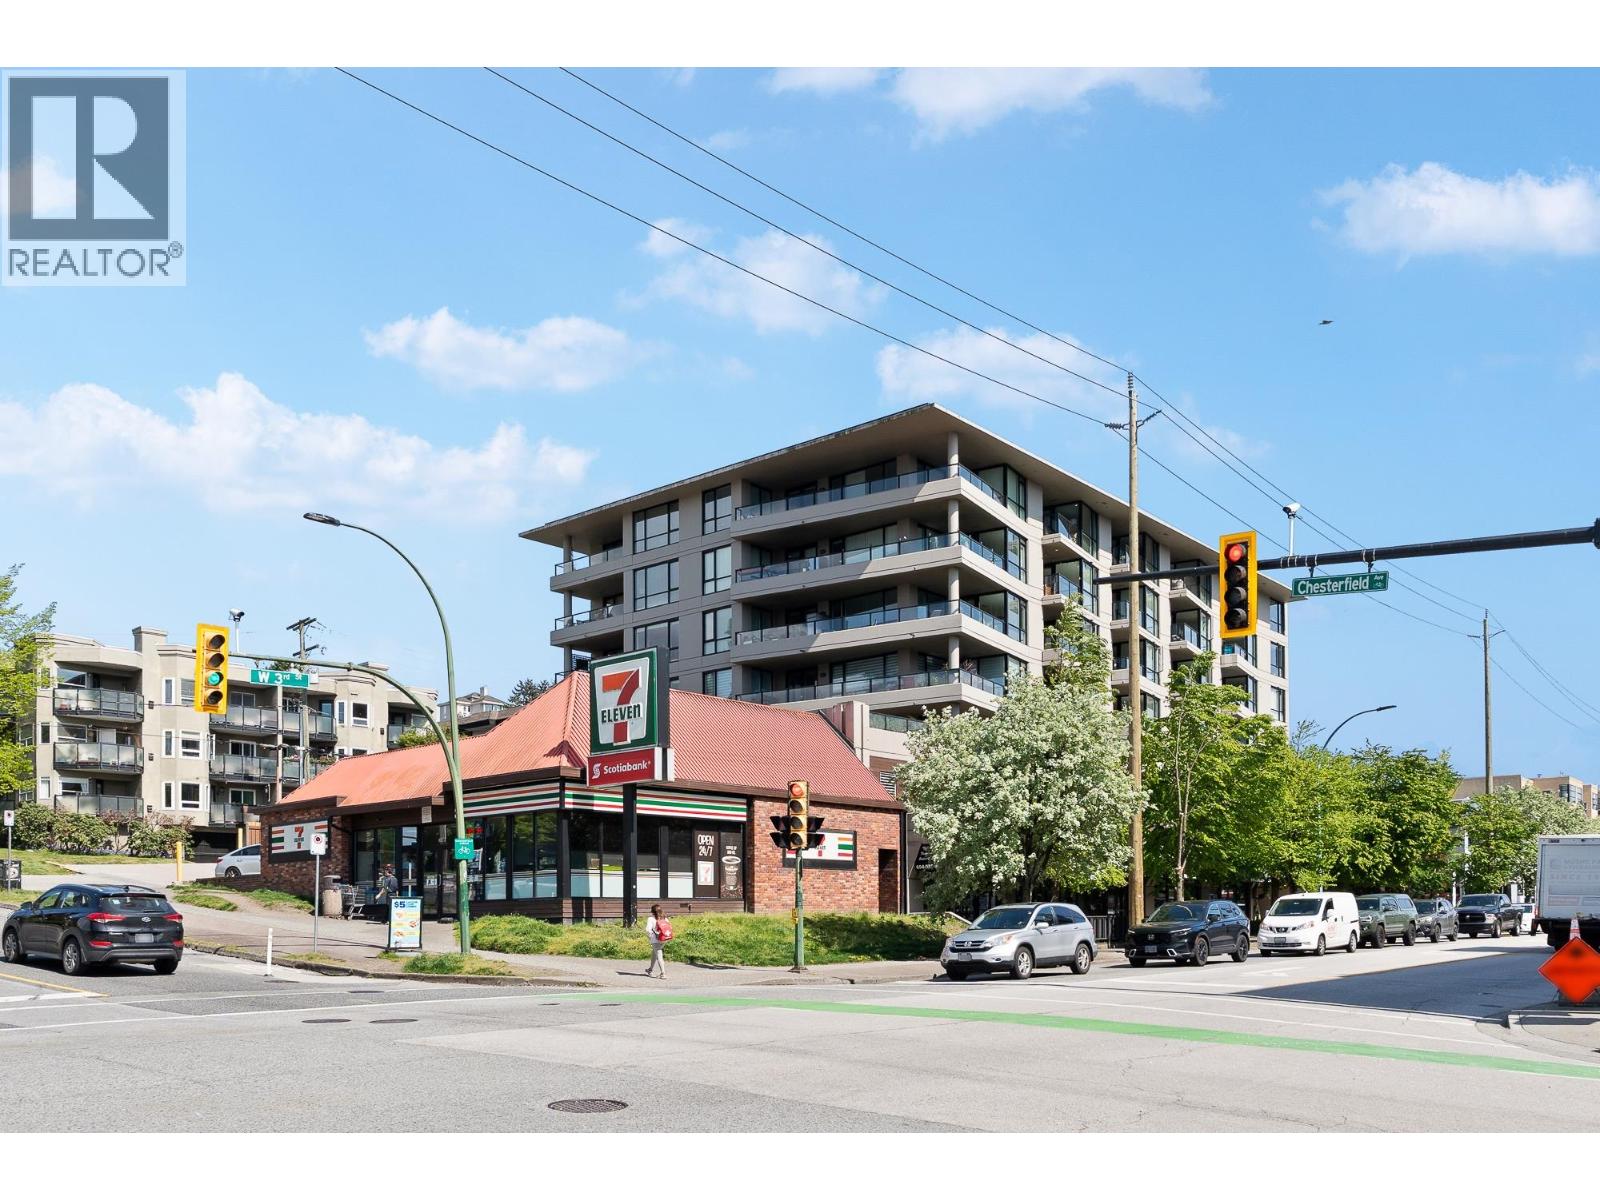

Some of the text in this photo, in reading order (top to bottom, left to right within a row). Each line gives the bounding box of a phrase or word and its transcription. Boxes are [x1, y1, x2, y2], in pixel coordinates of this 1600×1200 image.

[1297, 576, 1370, 595] Chesterfield
[258, 670, 270, 684] W
[274, 672, 290, 685] 3rd
[602, 668, 640, 744] 7
[697, 834, 715, 846] OPEN
[698, 845, 713, 857] 24/7
[394, 900, 406, 909] $5
